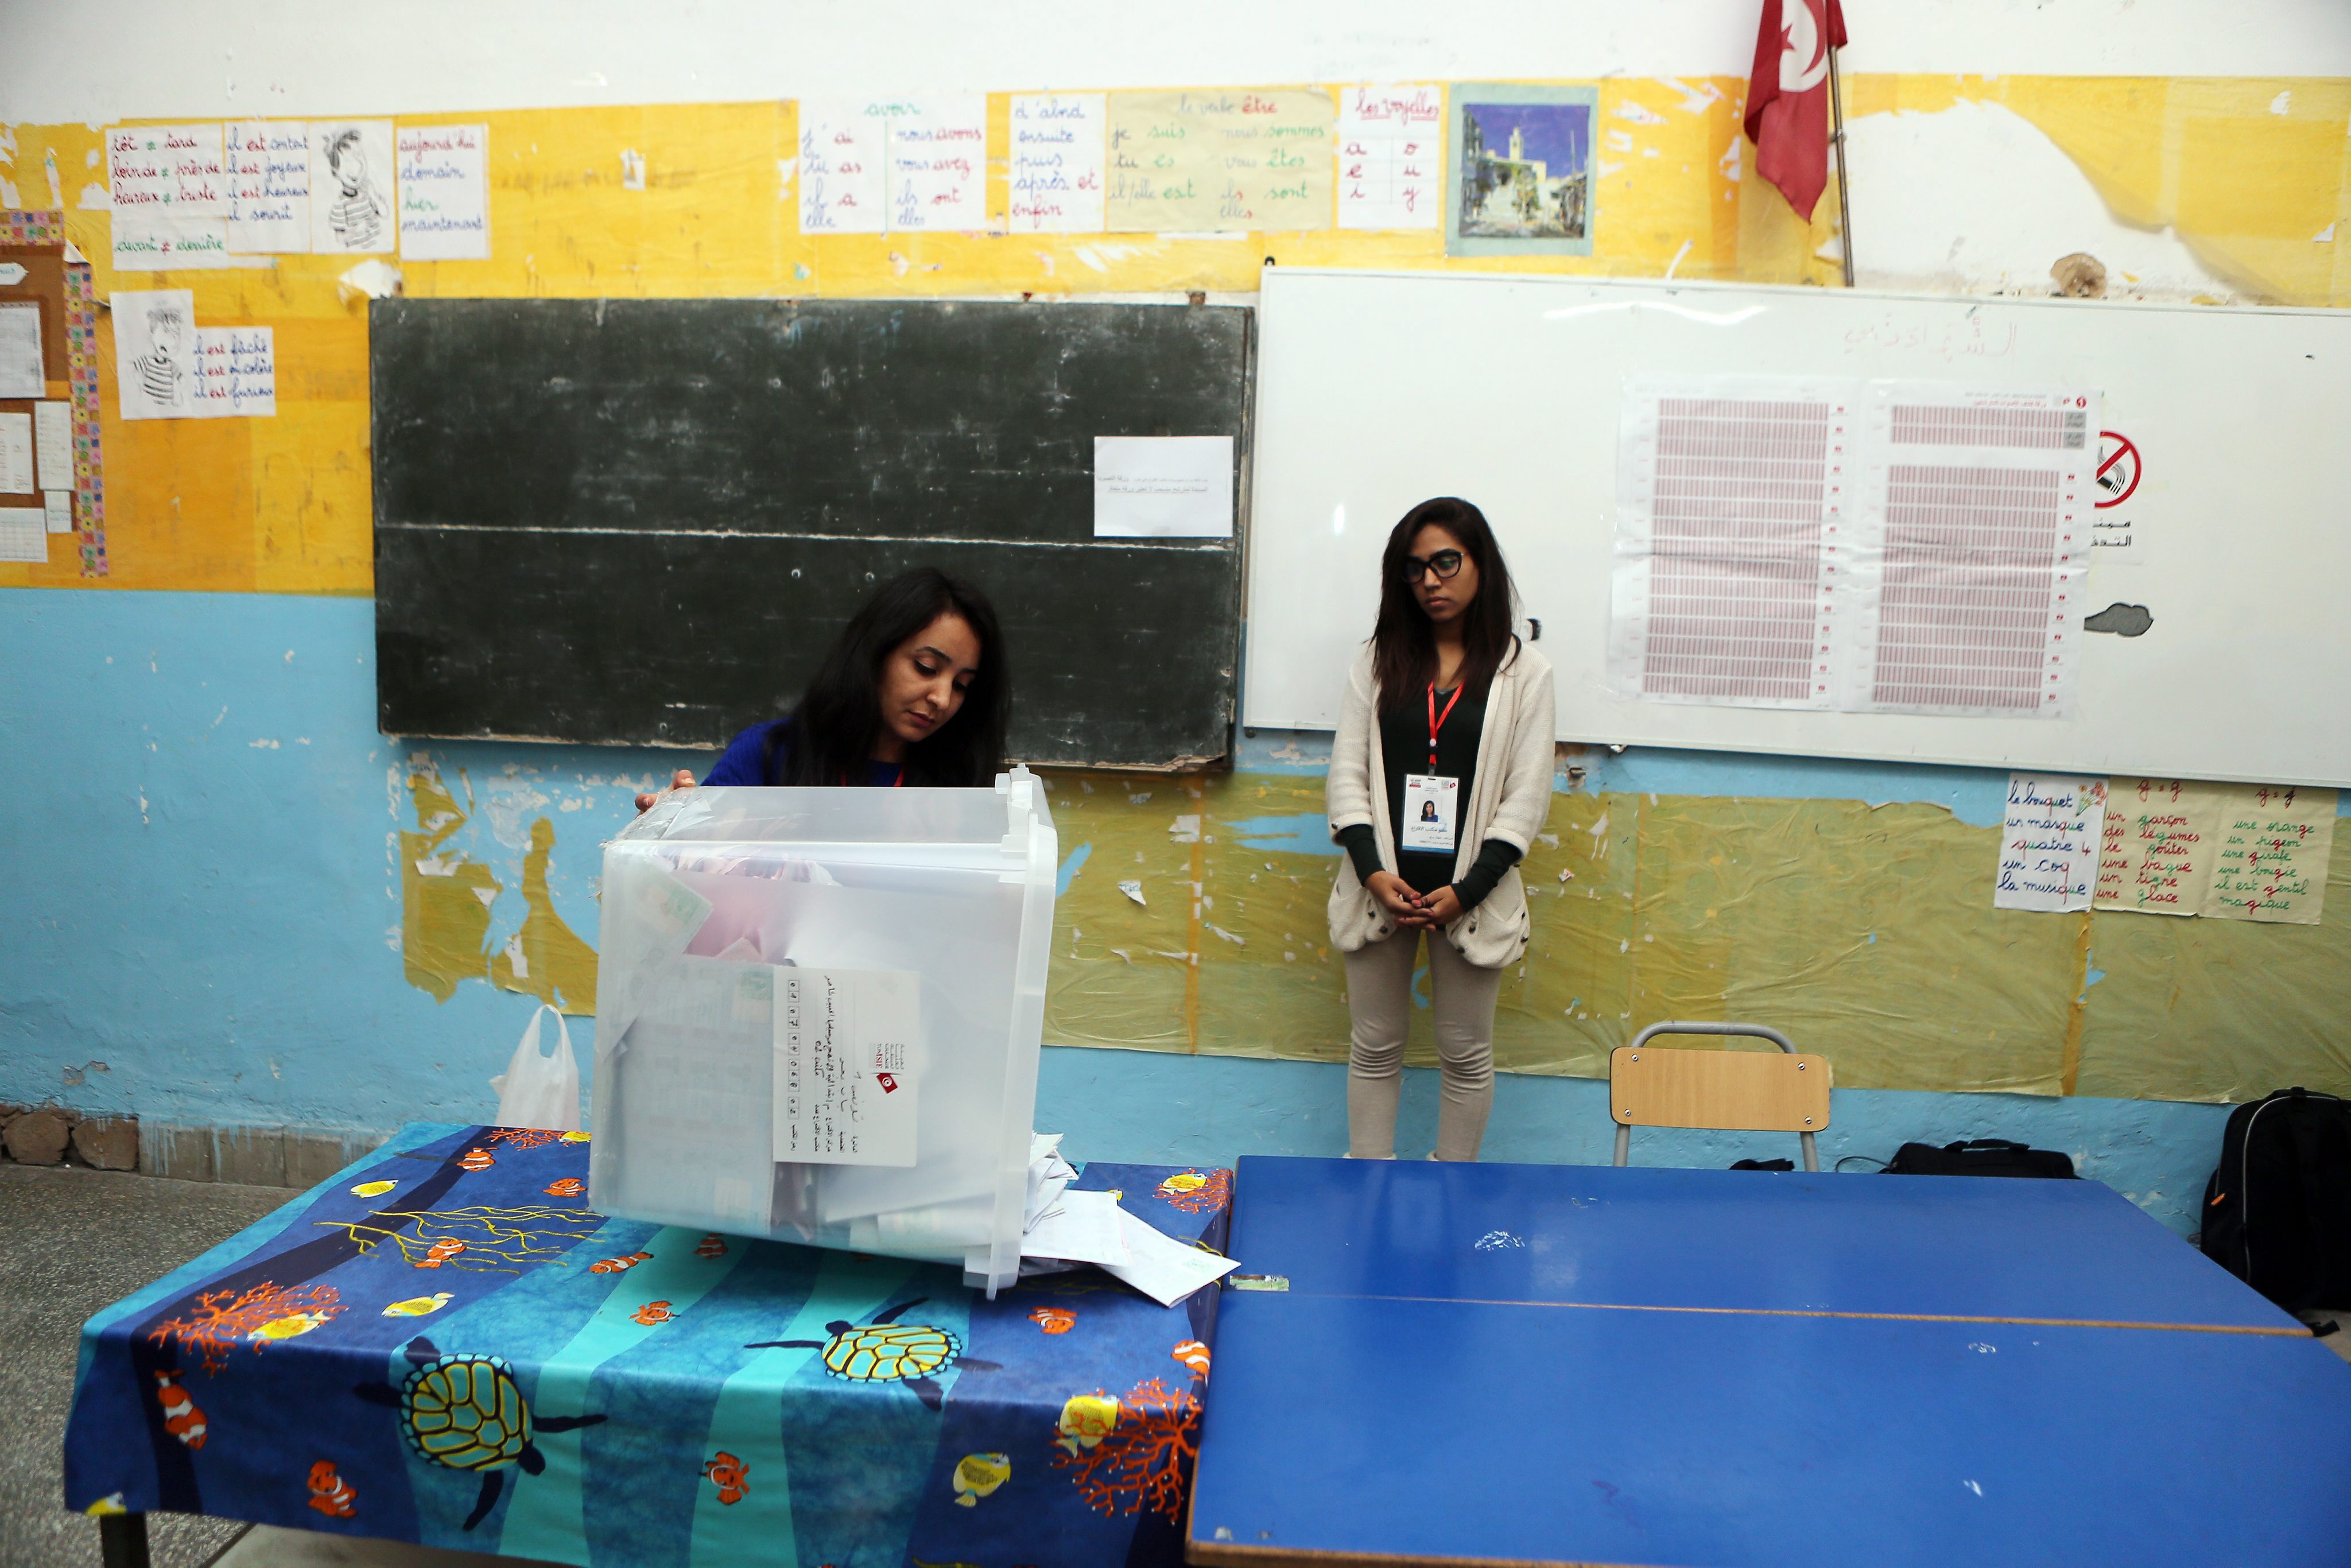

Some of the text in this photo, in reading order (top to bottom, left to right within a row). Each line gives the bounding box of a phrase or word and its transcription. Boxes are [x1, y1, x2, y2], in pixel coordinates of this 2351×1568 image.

[863, 101, 922, 117] avoir
[1242, 95, 1278, 114] être
[1355, 87, 1440, 126] les voyelles
[111, 131, 197, 152] tôt tard
[227, 126, 242, 151] il
[247, 131, 266, 151] est
[834, 127, 854, 145] ai
[896, 127, 981, 141] nous avons
[1019, 127, 1074, 143] ensuite
[1112, 122, 1324, 150] je suis nous sommes
[1115, 148, 1305, 169] tu es vous êtes
[1345, 142, 1419, 156] a o
[112, 154, 141, 178] loin
[143, 162, 157, 177] de
[205, 160, 220, 174] de
[227, 153, 306, 184] il est joyeux
[401, 160, 465, 181] demain
[839, 162, 863, 174] as
[895, 158, 929, 171] vous
[933, 157, 971, 181] avez
[1014, 151, 1062, 176] puis
[1346, 164, 1421, 178] e u
[228, 178, 309, 199] il est heureux
[1077, 167, 1098, 190] et
[1163, 177, 1197, 199] est
[1221, 177, 1243, 200] ils
[1264, 180, 1309, 199] sont
[114, 180, 218, 205] heureux triste
[403, 185, 440, 211] hier
[803, 176, 962, 208] il a ils ont
[1350, 182, 1421, 214] i y
[228, 200, 293, 221] il sourit
[806, 205, 836, 228] elle
[1012, 194, 1062, 230] enfin
[1220, 199, 1252, 219] elles
[401, 213, 483, 231] maintenant
[193, 334, 205, 355] il
[207, 343, 226, 355] est
[193, 356, 206, 377] il
[208, 366, 225, 377] est
[243, 355, 272, 374] colère
[193, 376, 273, 407] il est furieux
[2090, 534, 2132, 546] التدخ
[2008, 779, 2073, 817] le bouquet
[2137, 779, 2183, 803] g g
[2255, 787, 2269, 808] g
[2007, 817, 2084, 840] un masque
[2106, 811, 2189, 829] un garçon
[2233, 820, 2315, 840] une orange
[2103, 823, 2200, 844] des légumes
[2227, 835, 2302, 851] un pigeon
[2011, 837, 2091, 861] quatre 4
[2104, 837, 2189, 860] le goûter
[2221, 849, 2292, 867] une girafe
[2003, 859, 2069, 886] un coq
[2101, 849, 2192, 876] une bague
[2218, 861, 2297, 883] une bougie
[1997, 870, 2086, 906] la musique
[2099, 870, 2178, 888] un tigre
[2214, 875, 2309, 899] il est gentil
[2096, 884, 2179, 909] une glace
[2219, 895, 2291, 916] magique
